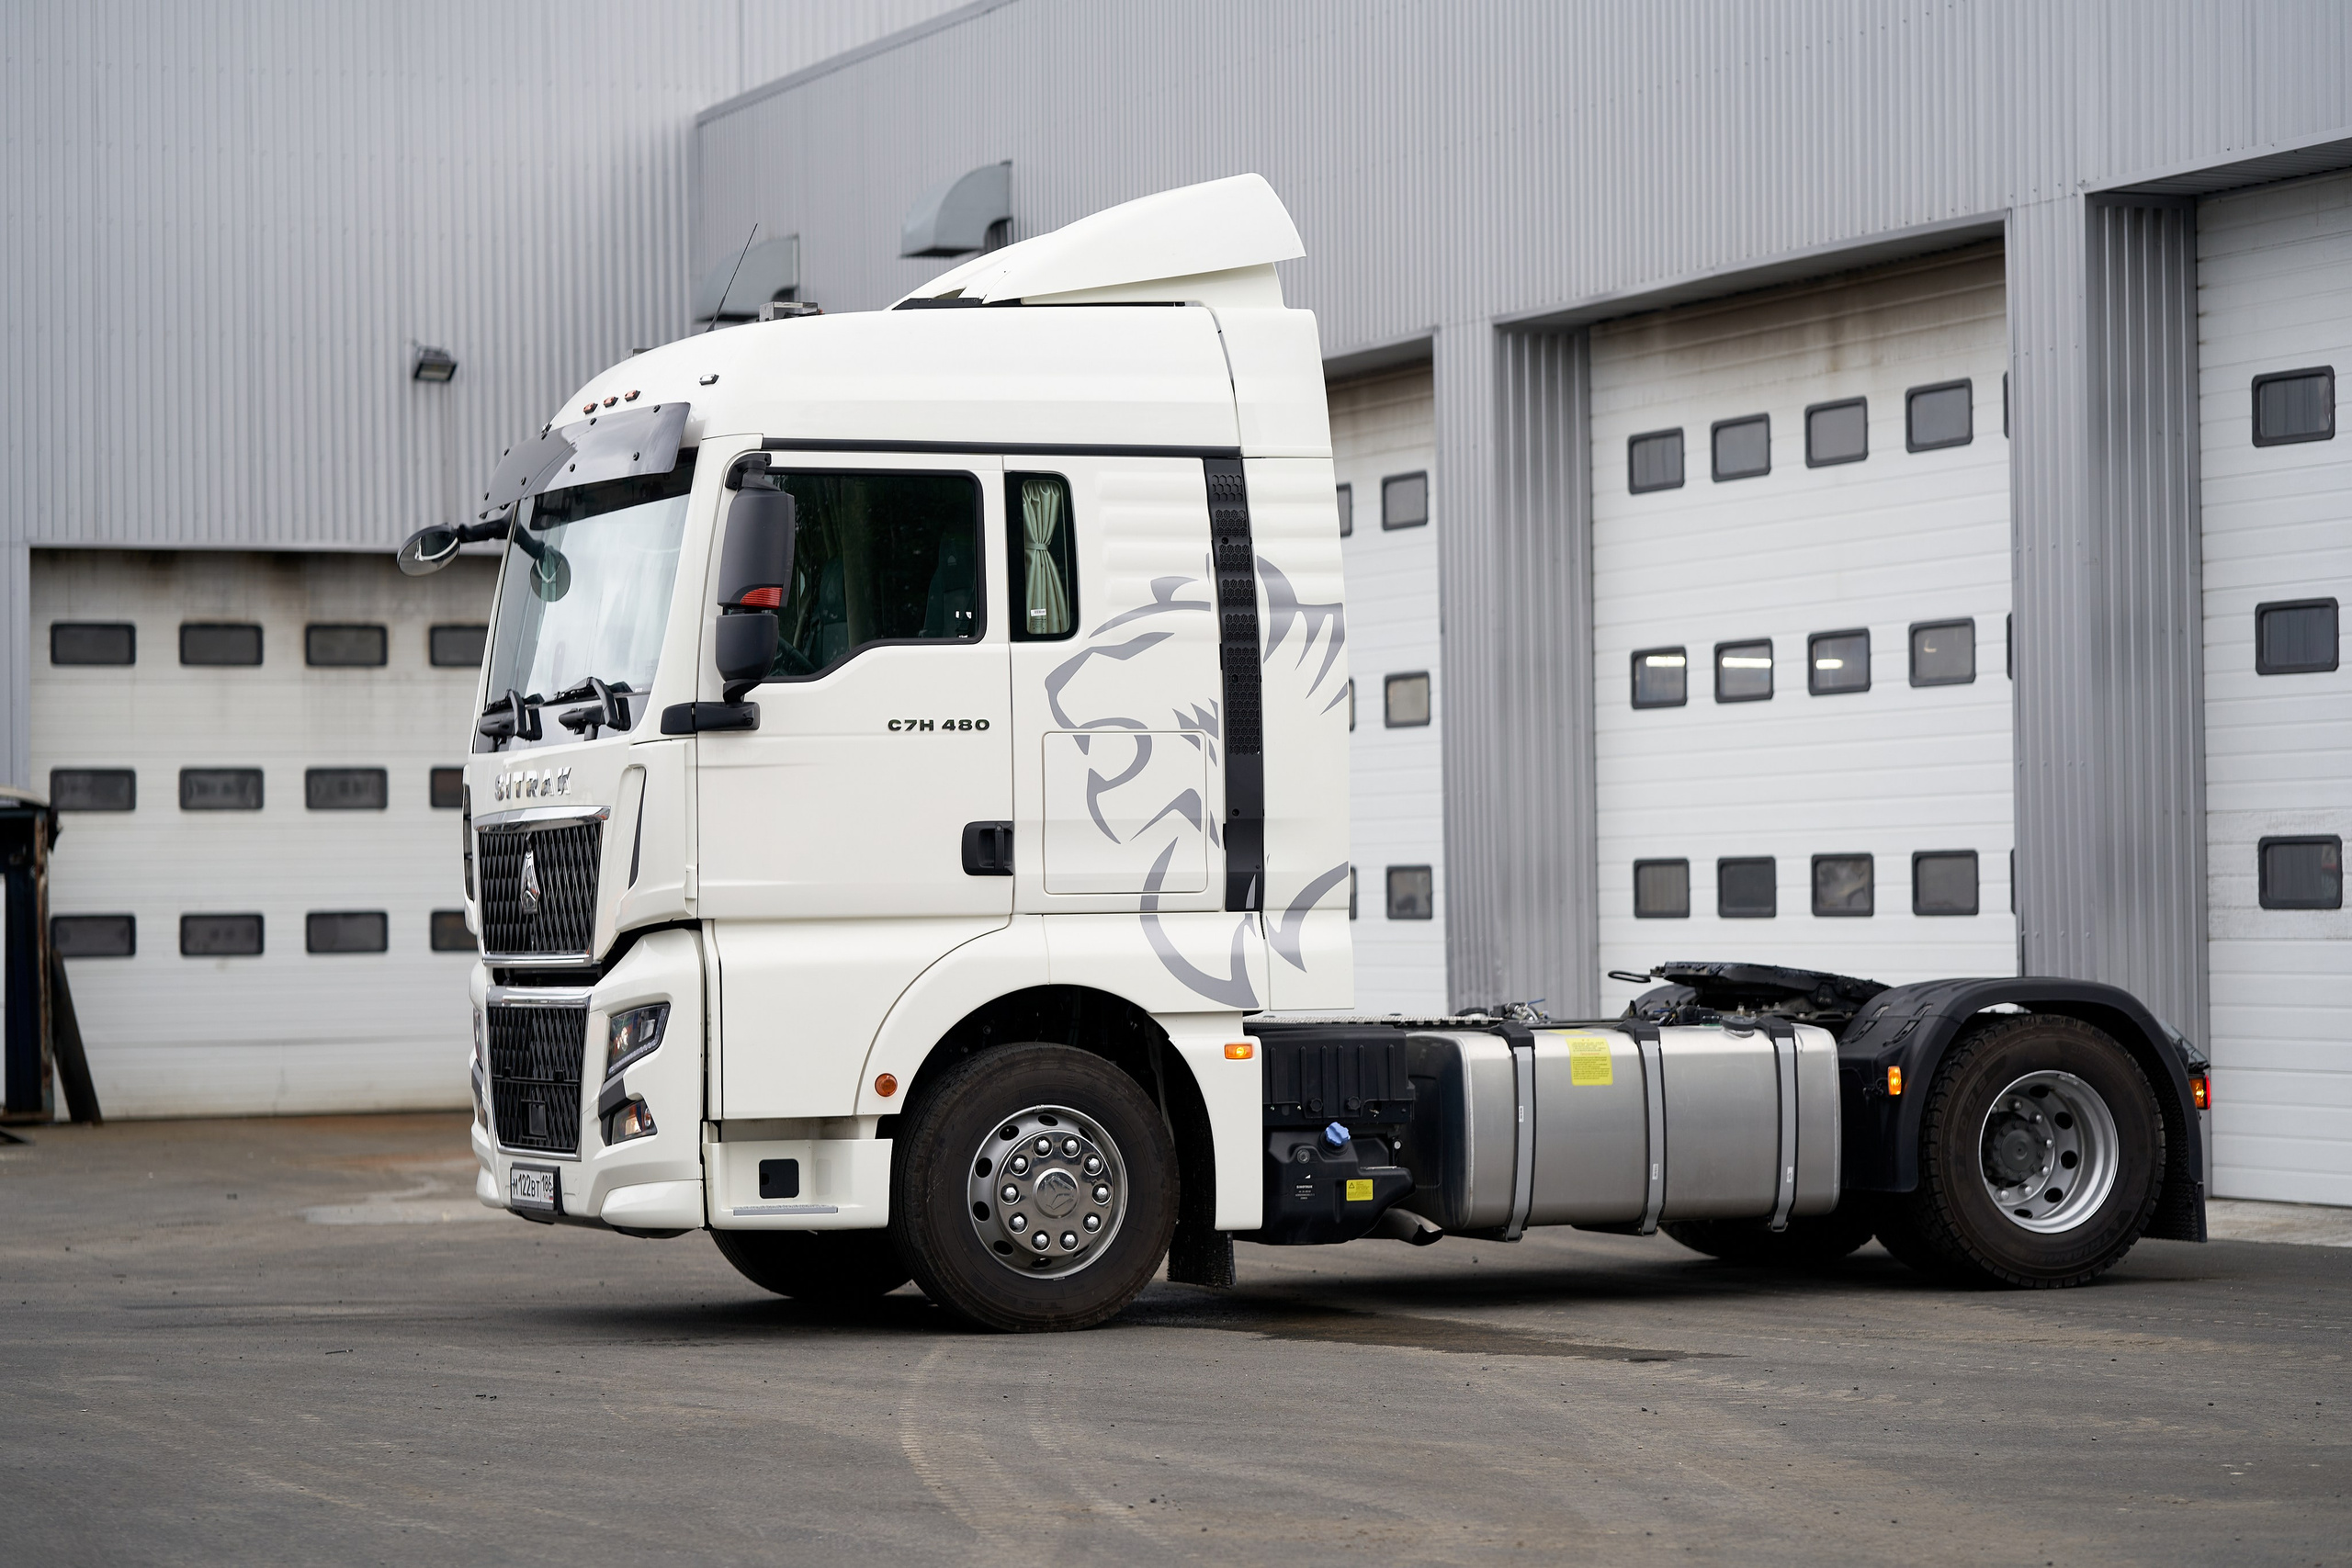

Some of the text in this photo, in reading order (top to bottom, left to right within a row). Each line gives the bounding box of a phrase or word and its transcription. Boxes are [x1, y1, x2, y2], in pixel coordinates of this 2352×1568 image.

[888, 719, 990, 731] C7H 480
[494, 766, 572, 802] SITRAK
